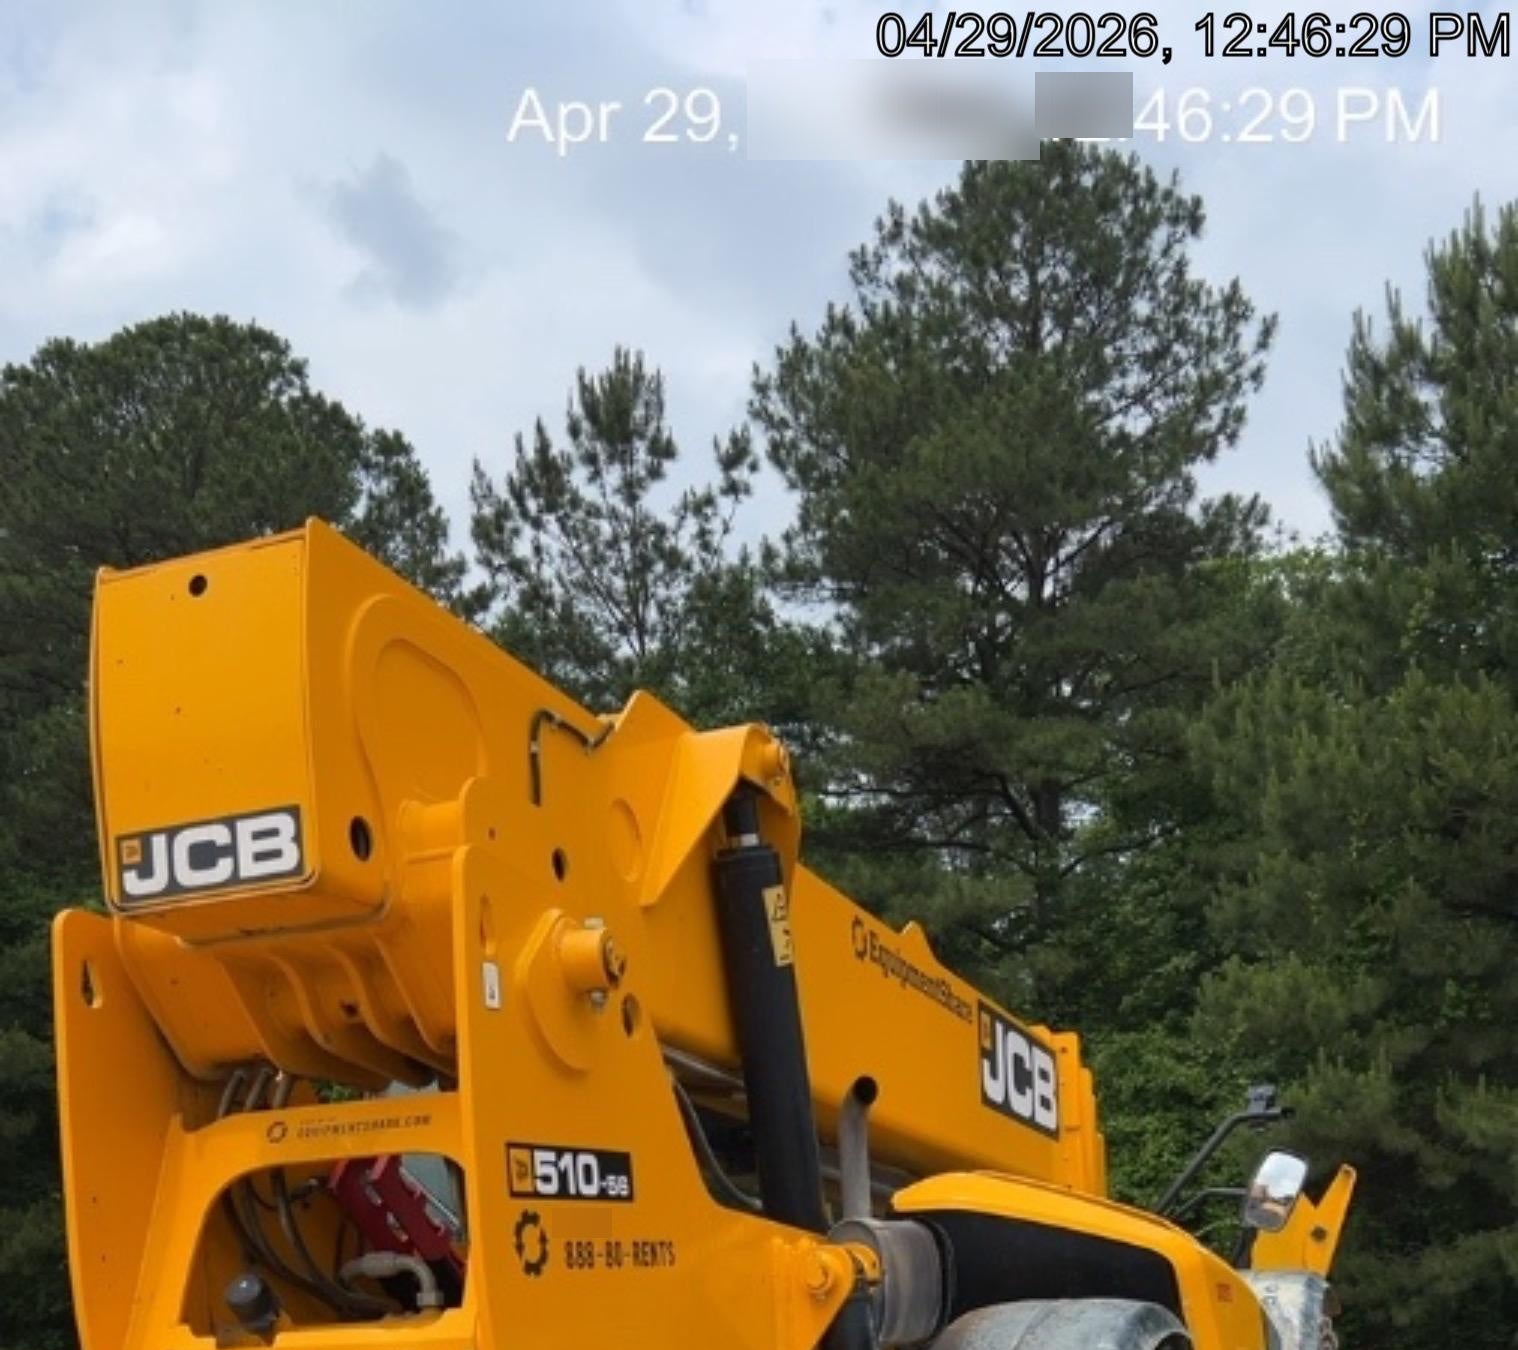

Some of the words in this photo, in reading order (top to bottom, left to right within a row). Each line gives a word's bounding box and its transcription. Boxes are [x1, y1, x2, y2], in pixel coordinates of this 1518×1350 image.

[122, 811, 300, 896] JCB
[982, 1018, 1058, 1131] JCB
[532, 1147, 631, 1198] 510-56
